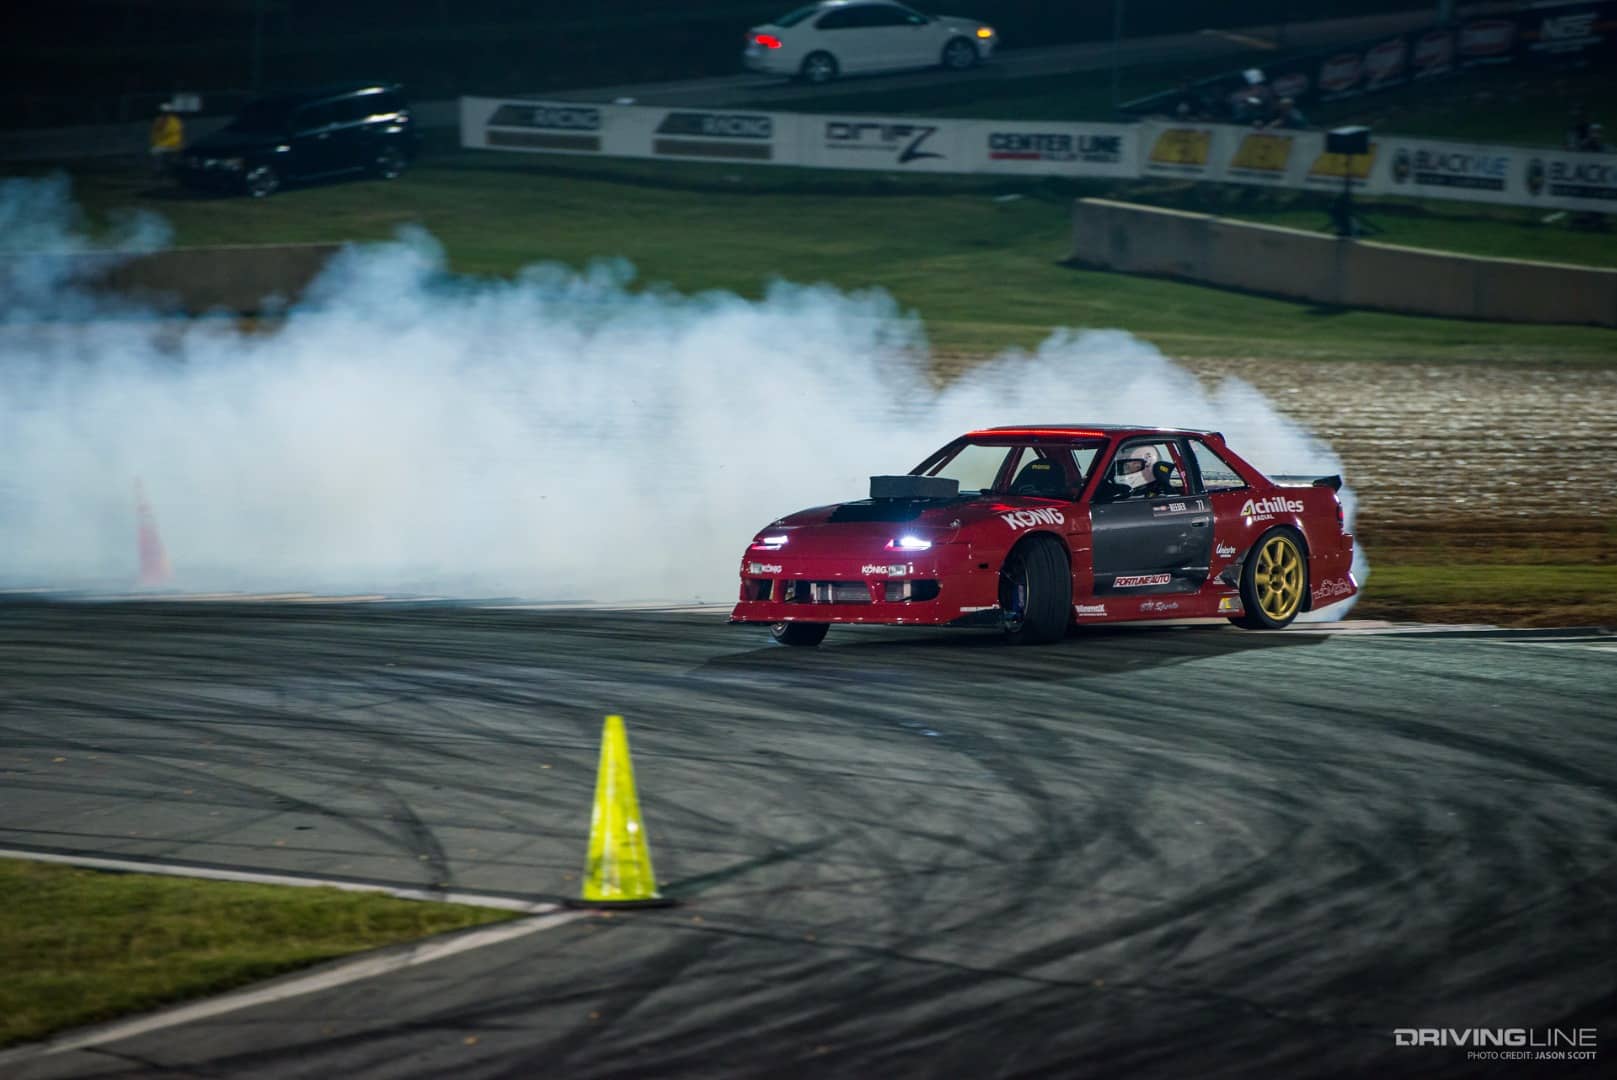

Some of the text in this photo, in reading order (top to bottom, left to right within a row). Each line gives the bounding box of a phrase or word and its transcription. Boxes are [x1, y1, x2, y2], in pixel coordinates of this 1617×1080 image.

[988, 133, 1121, 152] CENTER LINE
[1240, 496, 1304, 516] Achilles
[1115, 574, 1170, 586] FORTUNE AUTO
